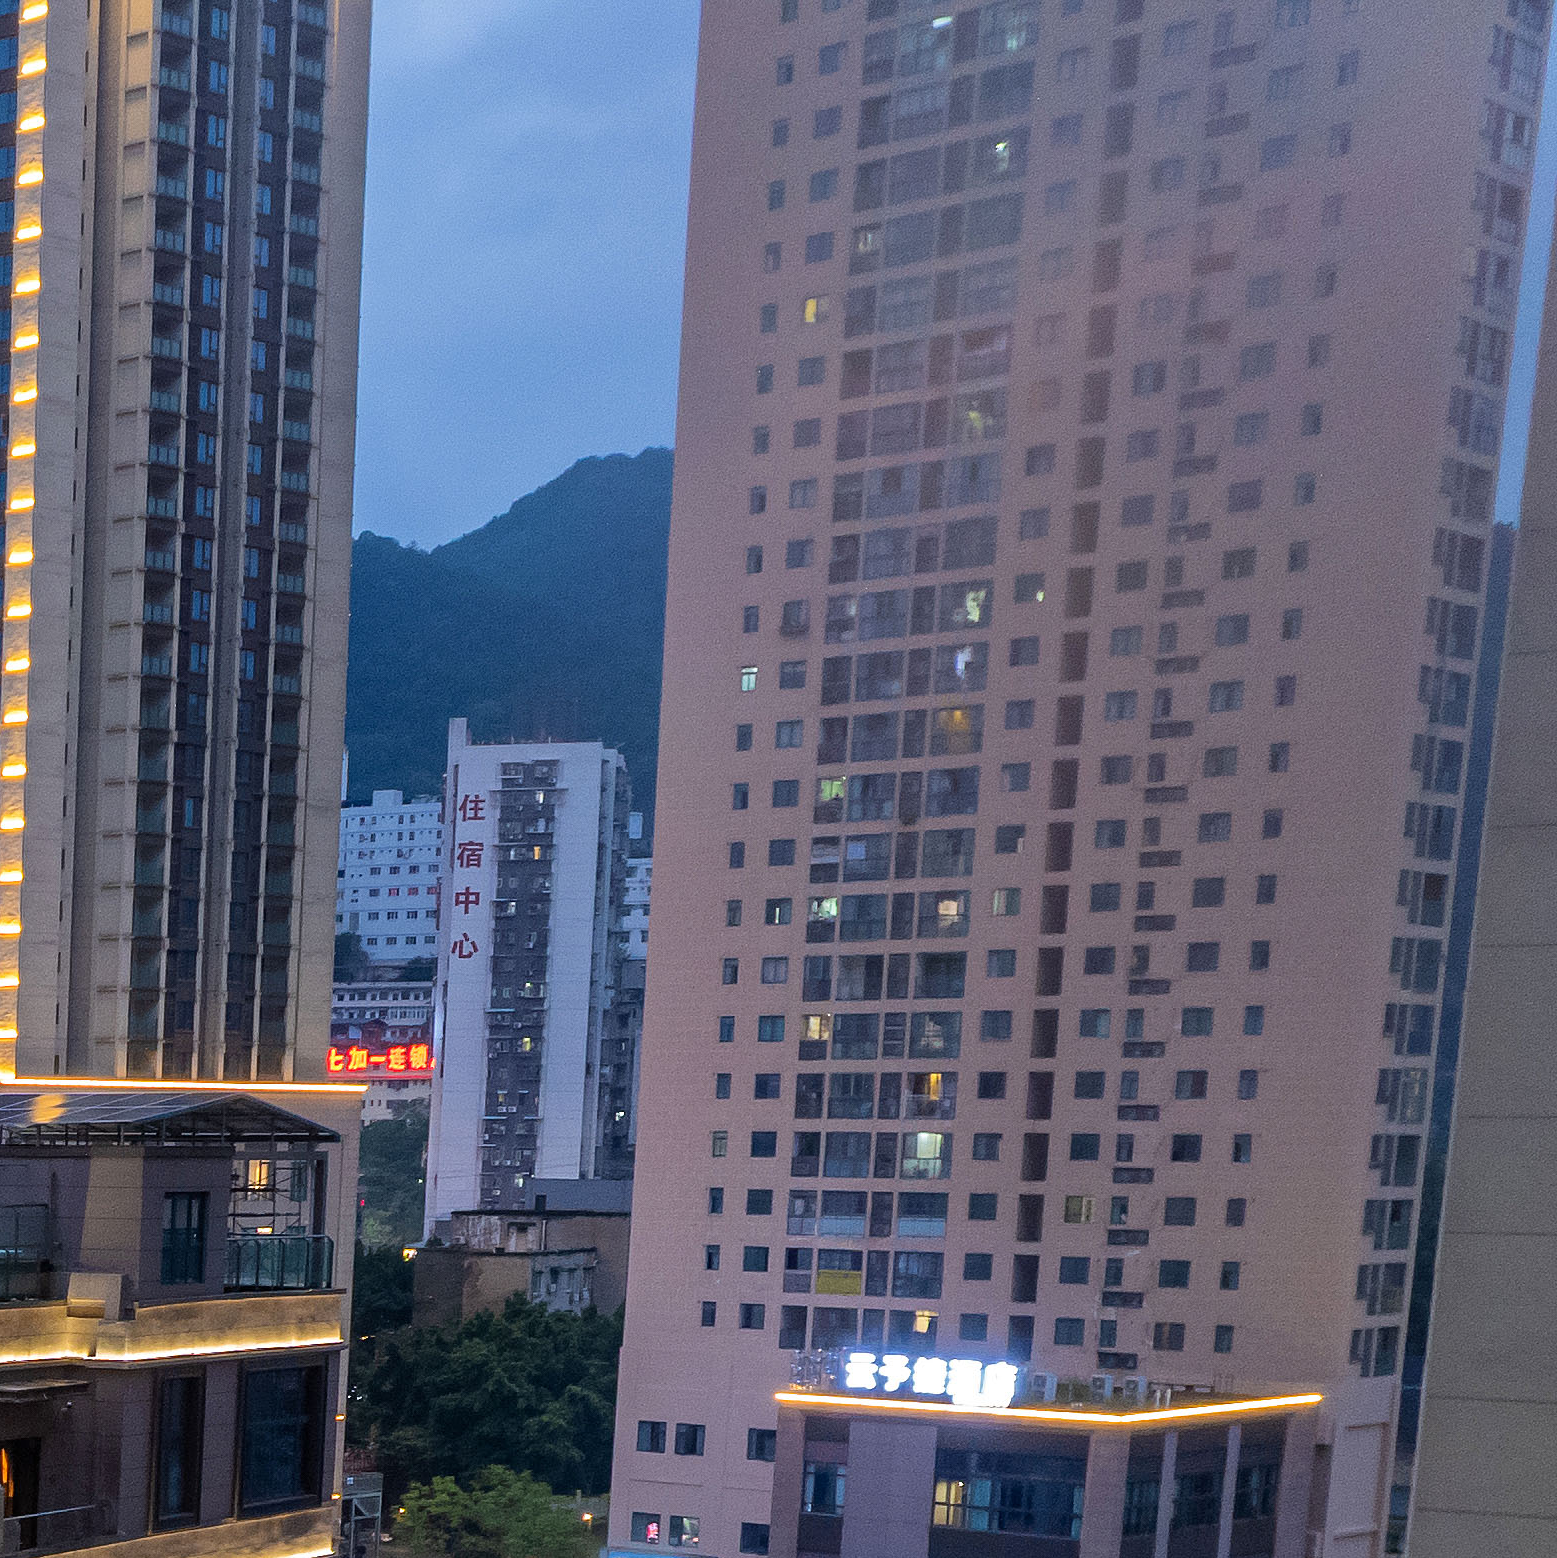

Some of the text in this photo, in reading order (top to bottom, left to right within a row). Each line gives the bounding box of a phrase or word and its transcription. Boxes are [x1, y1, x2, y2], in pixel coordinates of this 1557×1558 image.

[450, 794, 487, 960] 住宿中心
[327, 1043, 436, 1073] 七加一连锁
